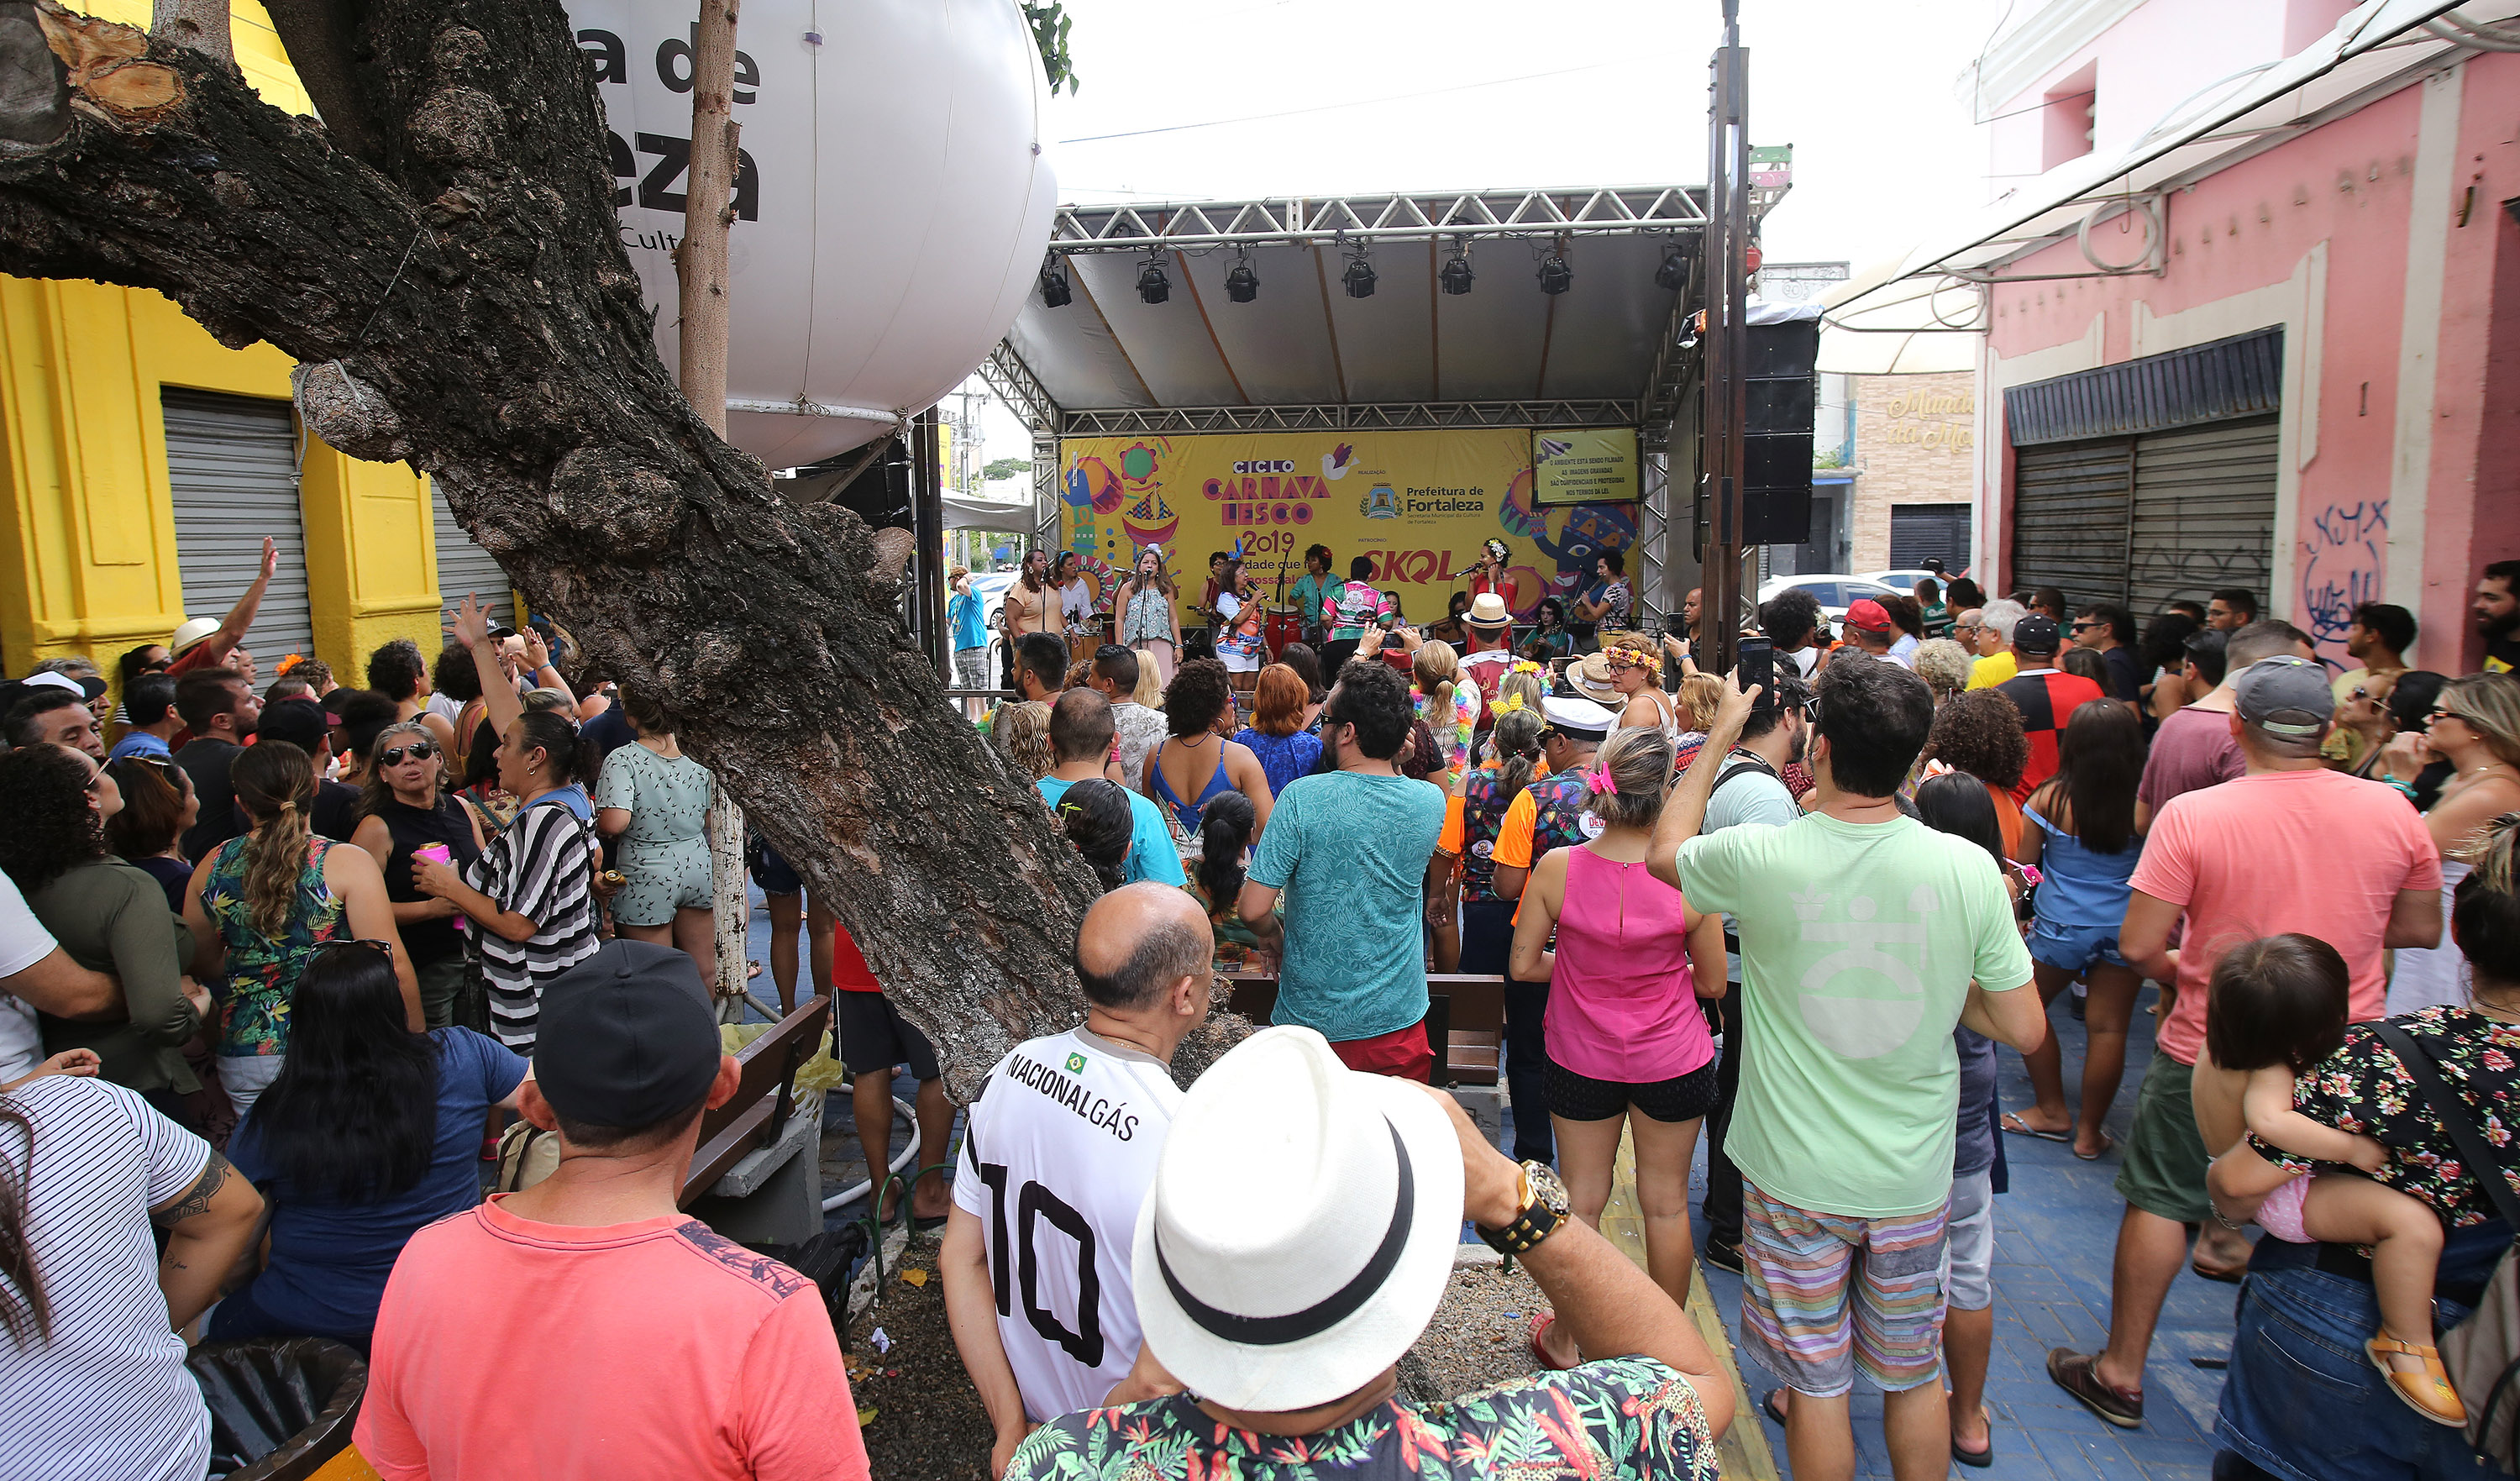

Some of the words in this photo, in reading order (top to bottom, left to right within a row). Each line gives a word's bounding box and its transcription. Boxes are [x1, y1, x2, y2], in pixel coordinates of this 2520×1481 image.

[1233, 460, 1294, 473] CICLO
[1202, 475, 1331, 501] CARNAVA
[1407, 486, 1466, 496] Prefeitura
[1469, 486, 1483, 496] de
[1221, 502, 1314, 526] LESCO
[1407, 498, 1483, 512] Fortaleza
[1242, 529, 1294, 556] 2019
[979, 1162, 1105, 1369] 10
